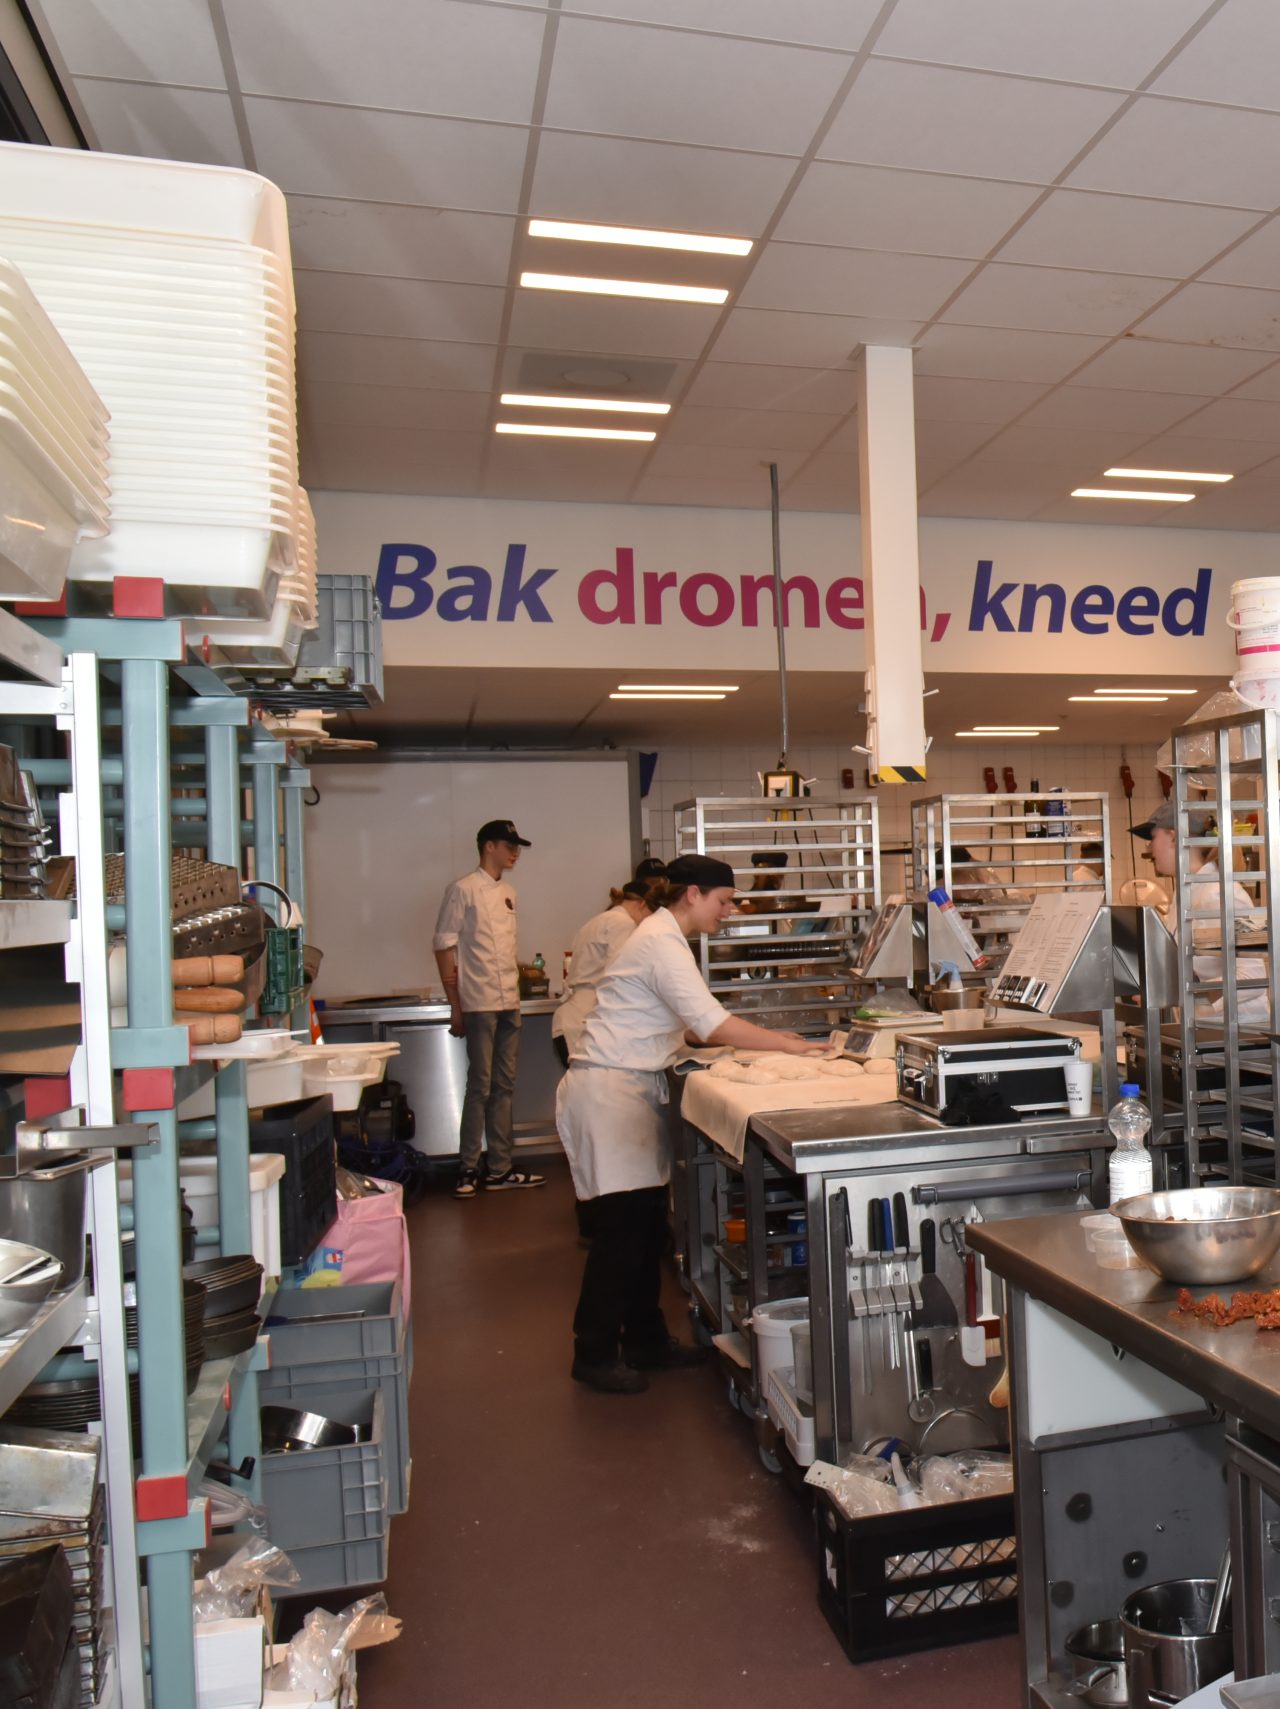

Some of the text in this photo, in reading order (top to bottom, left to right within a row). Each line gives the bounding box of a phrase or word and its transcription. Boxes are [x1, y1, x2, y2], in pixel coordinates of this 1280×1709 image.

[375, 543, 559, 623] Bak
[577, 547, 951, 643] drome,
[968, 560, 1212, 637] kneed
